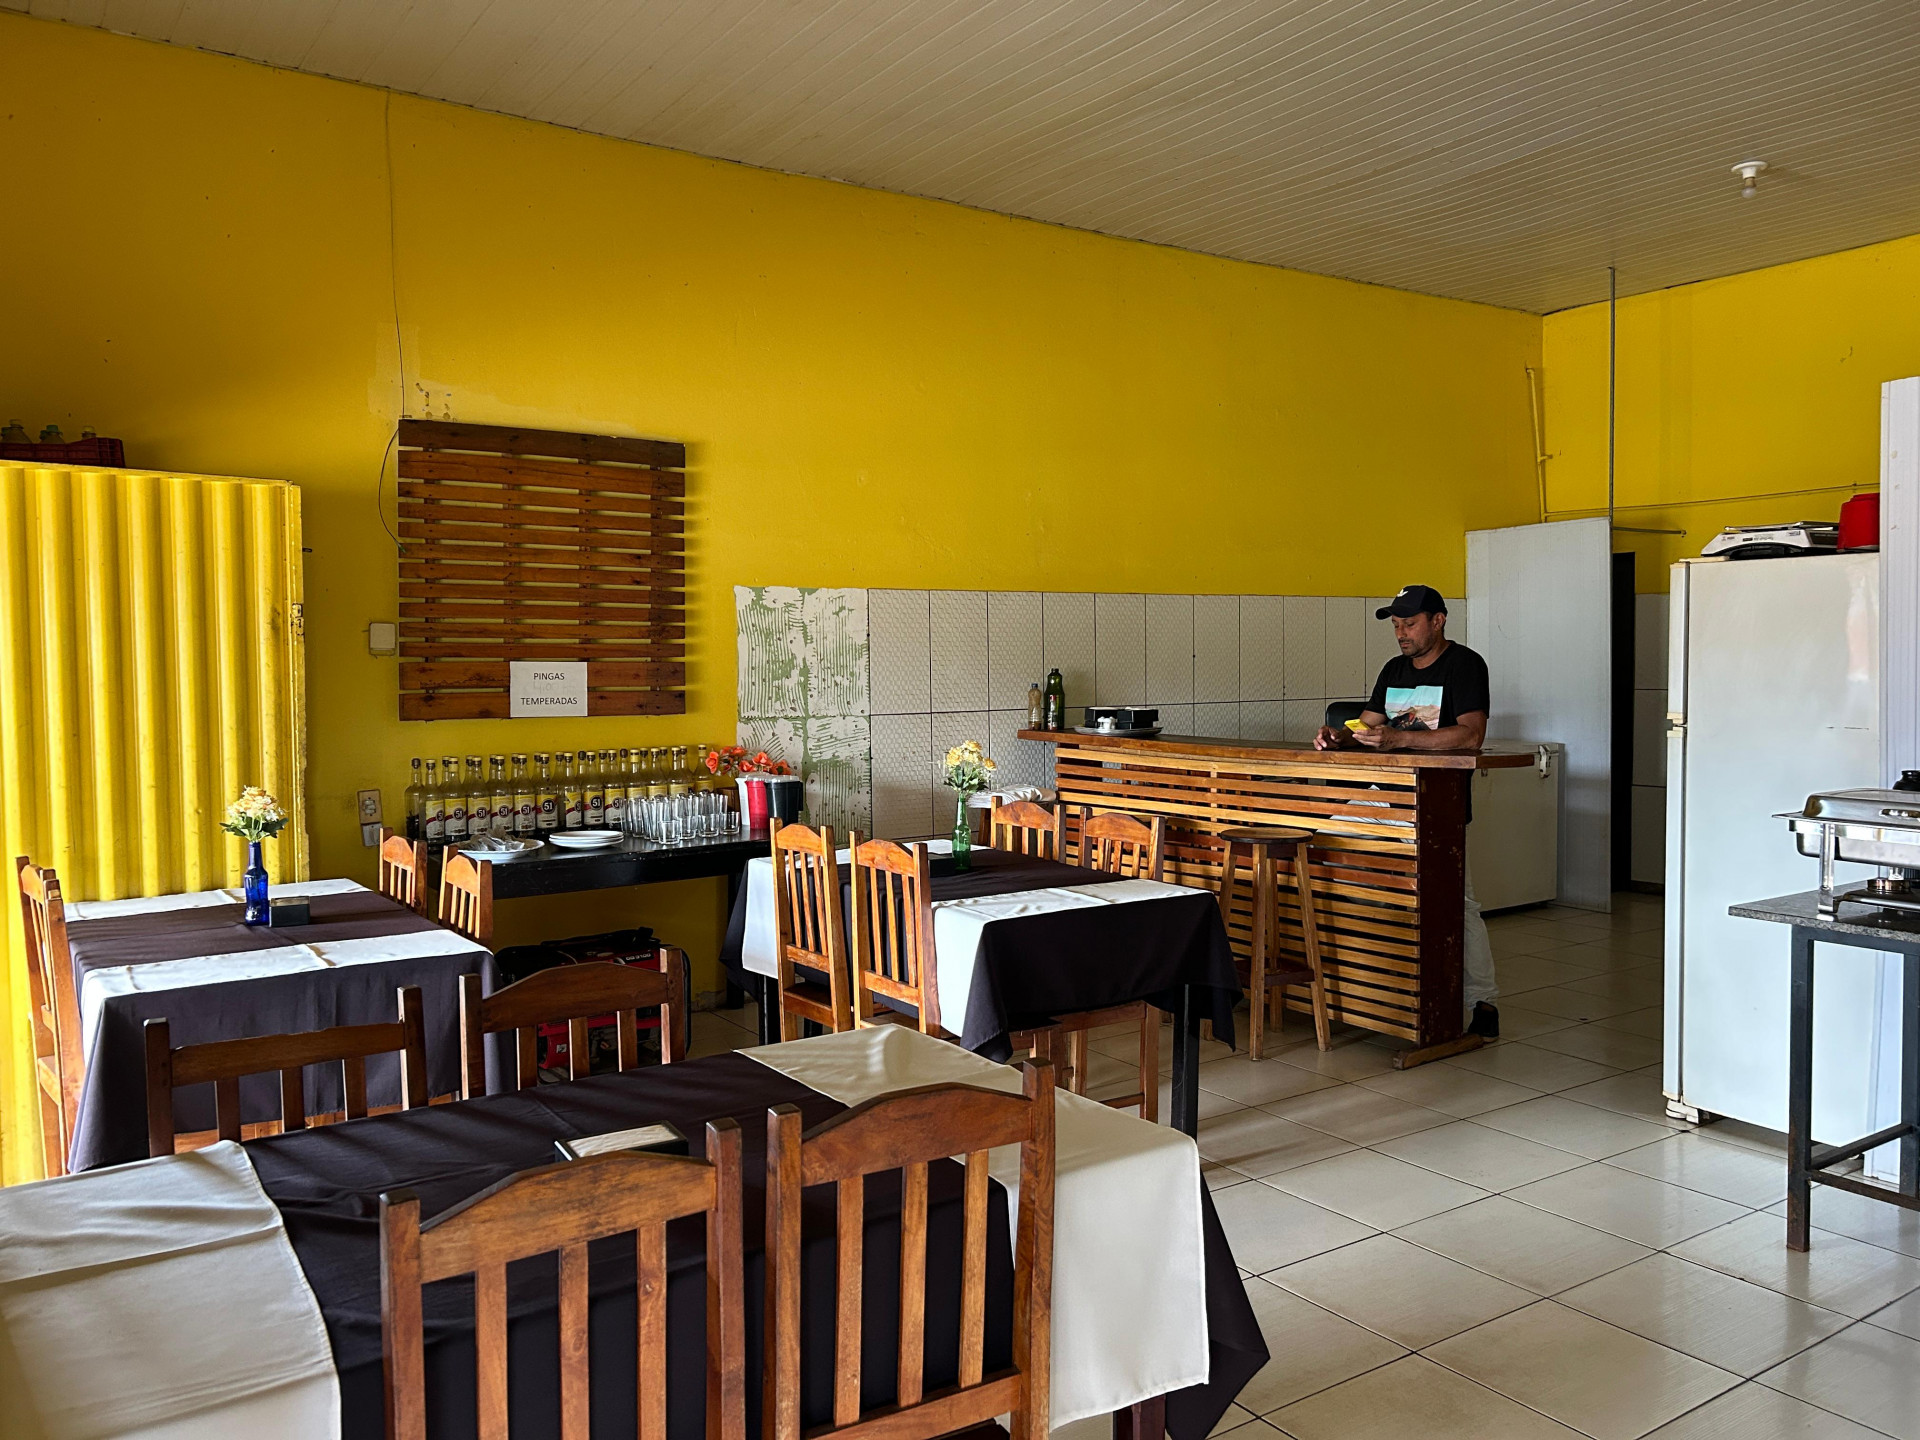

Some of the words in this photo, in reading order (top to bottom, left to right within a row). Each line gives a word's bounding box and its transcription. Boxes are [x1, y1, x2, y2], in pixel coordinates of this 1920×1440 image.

[533, 672, 565, 681] PINGAS
[520, 697, 578, 706] TEMPERADAS
[543, 802, 553, 811] 51
[592, 798, 601, 807] 51
[455, 810, 463, 819] 51
[478, 809, 485, 818] 51
[500, 807, 508, 816] 51
[522, 806, 530, 814] 51
